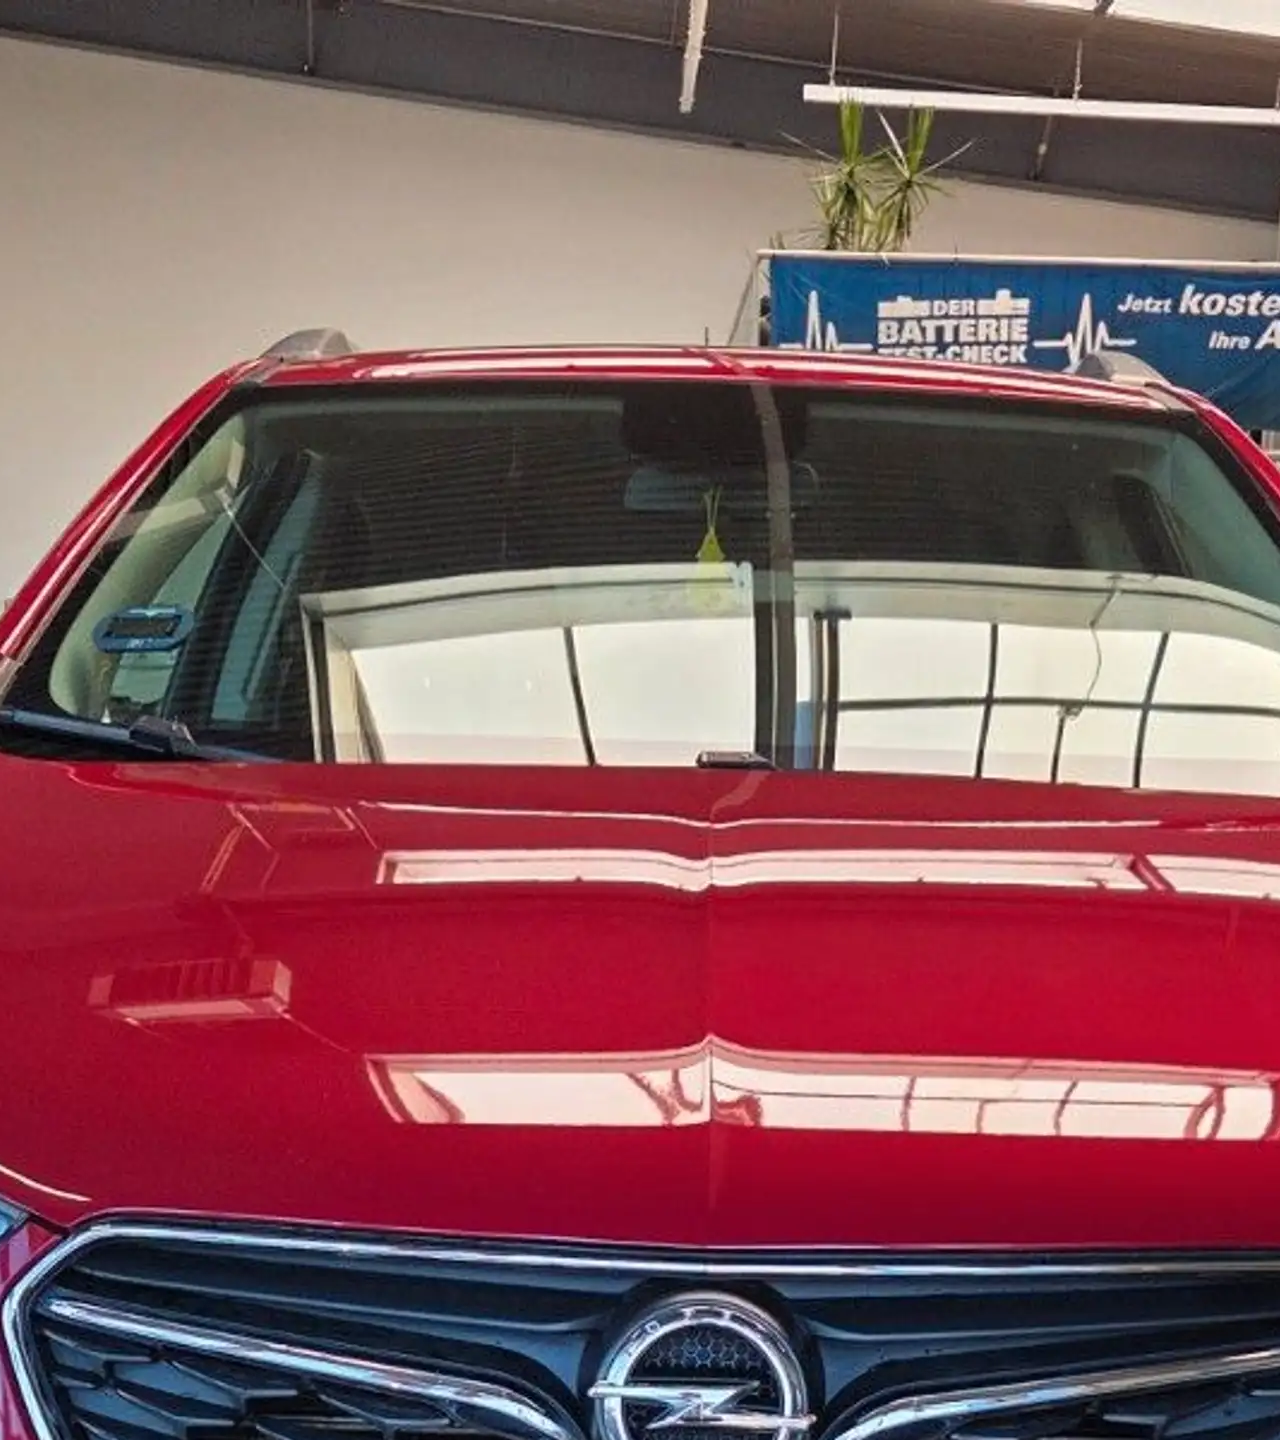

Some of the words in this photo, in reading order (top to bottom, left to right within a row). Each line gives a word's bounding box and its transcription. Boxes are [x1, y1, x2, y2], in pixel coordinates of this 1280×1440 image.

[931, 299, 976, 316] DER
[1117, 294, 1172, 314] Jetzt
[877, 317, 1029, 345] BATTERIE
[1208, 330, 1251, 349] Ihre
